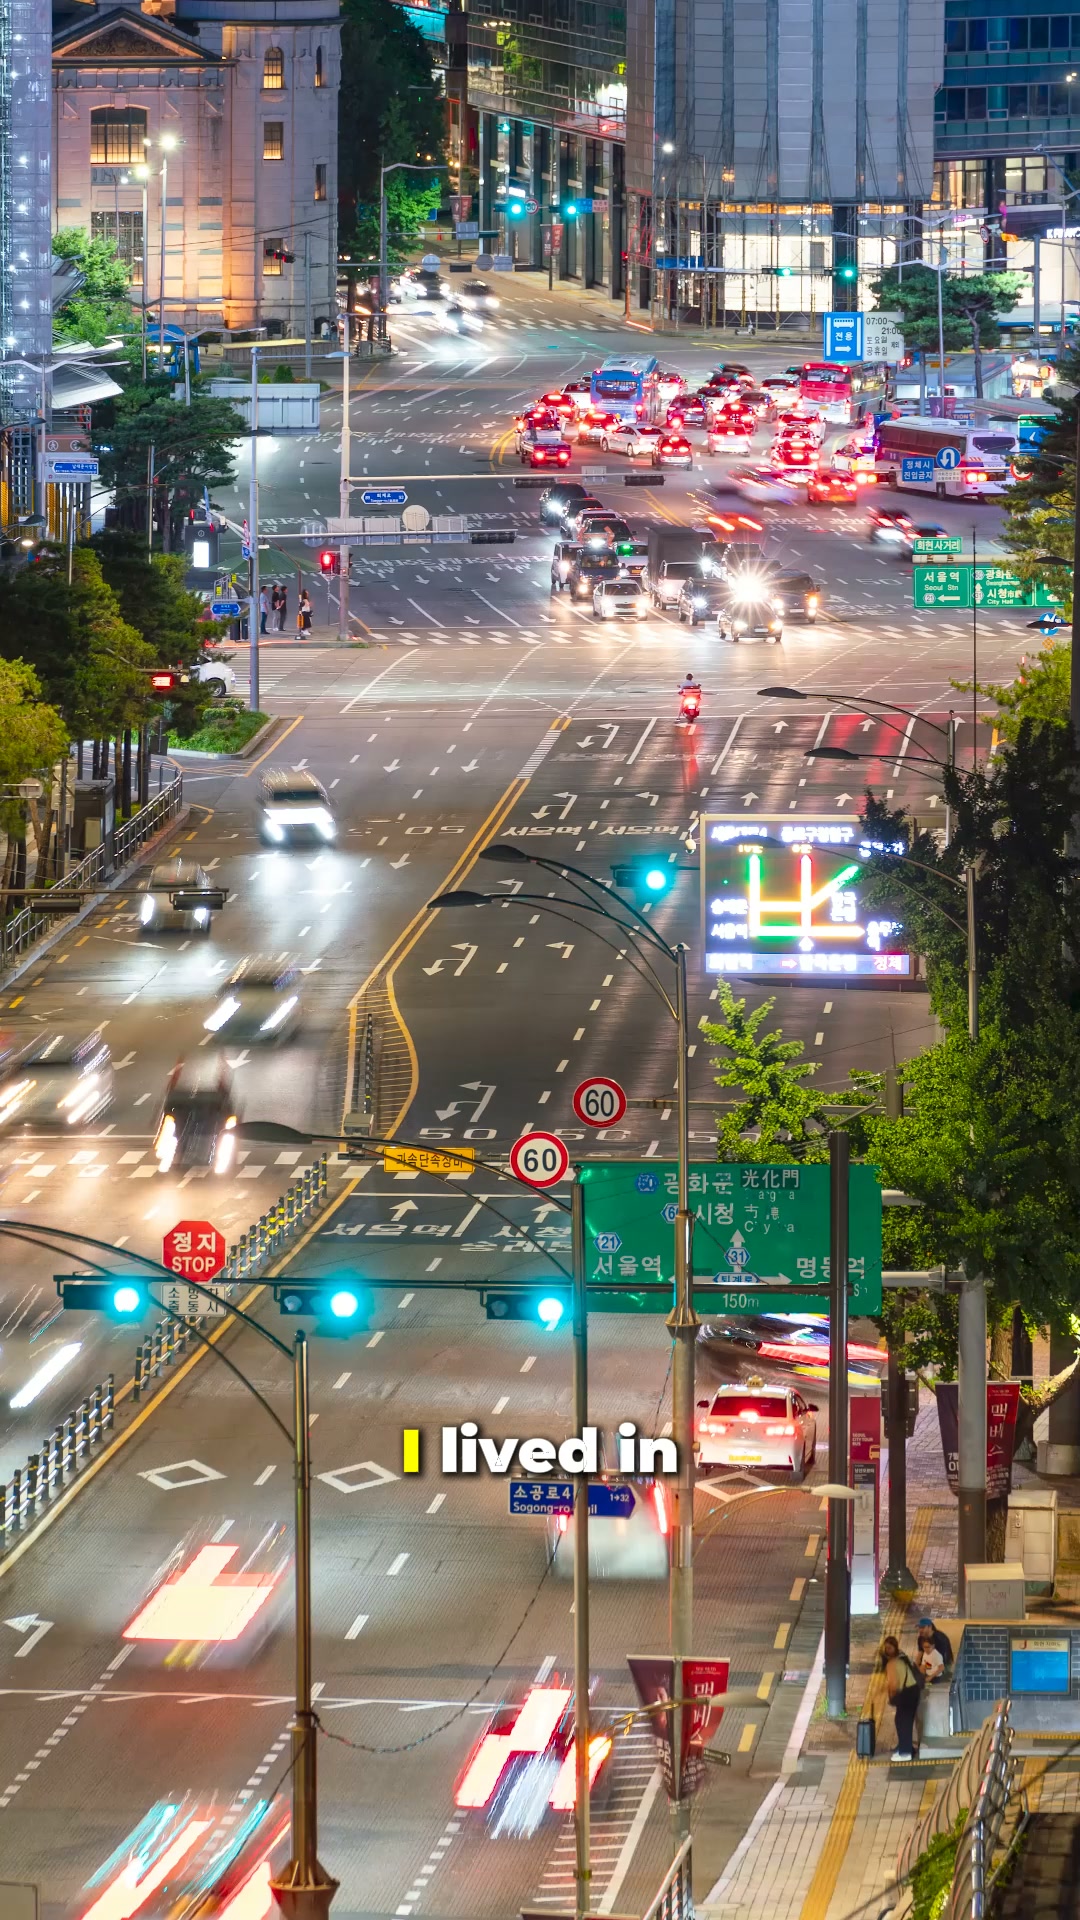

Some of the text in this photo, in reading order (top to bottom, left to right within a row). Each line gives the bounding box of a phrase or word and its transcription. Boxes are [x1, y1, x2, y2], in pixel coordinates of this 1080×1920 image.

[835, 331, 853, 342] 전용
[866, 336, 888, 344] 토요일
[866, 346, 888, 356] 공휴일
[906, 460, 930, 470] 정체시
[903, 471, 933, 480] 진입금지
[916, 540, 960, 551] 회현사거리
[923, 571, 960, 583] 서울역
[986, 588, 1007, 599] 시청
[987, 598, 1000, 606] City
[585, 1089, 615, 1117] 60
[418, 1127, 499, 1141] 50
[523, 1148, 558, 1173] 60
[663, 1172, 734, 1195] 광화문
[741, 1168, 800, 1189] 光化門
[695, 1202, 734, 1226] 시청
[320, 1223, 453, 1237] 서울역
[172, 1231, 217, 1254] 정지
[601, 1236, 616, 1250] 21
[731, 1250, 745, 1263] 31
[171, 1256, 217, 1273] STOP
[593, 1254, 662, 1277] 서울역
[722, 1293, 760, 1309] 150m
